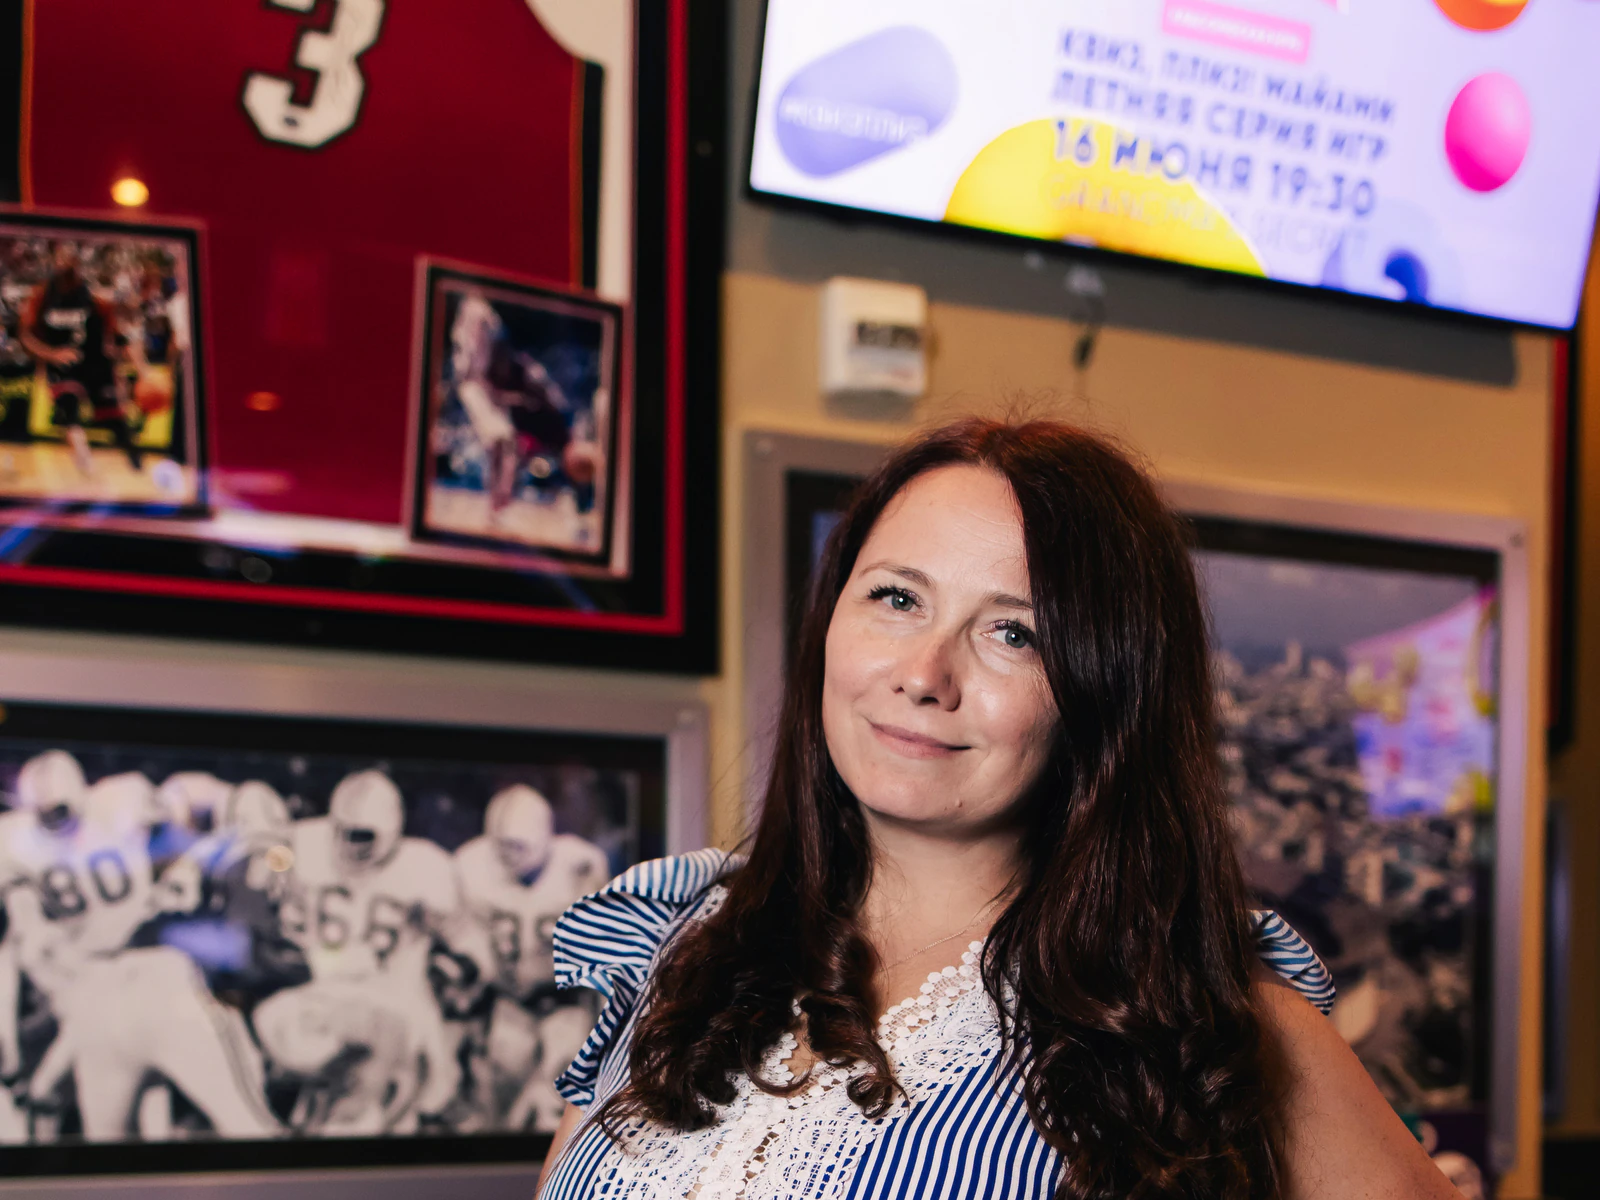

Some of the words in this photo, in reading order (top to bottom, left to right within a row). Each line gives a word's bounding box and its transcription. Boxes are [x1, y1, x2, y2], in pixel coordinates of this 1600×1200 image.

[238, 0, 388, 150] 3
[1053, 69, 1193, 125] ЛЕТНЯЯ
[1205, 102, 1318, 151] СЕРИЯ
[1328, 126, 1388, 159] ИГР
[1264, 73, 1397, 123] МАЙАМИ
[1055, 119, 1094, 163] 16
[1112, 135, 1253, 187] ИЮНЯ
[1270, 162, 1377, 218] 19:30
[38, 846, 132, 921] 80
